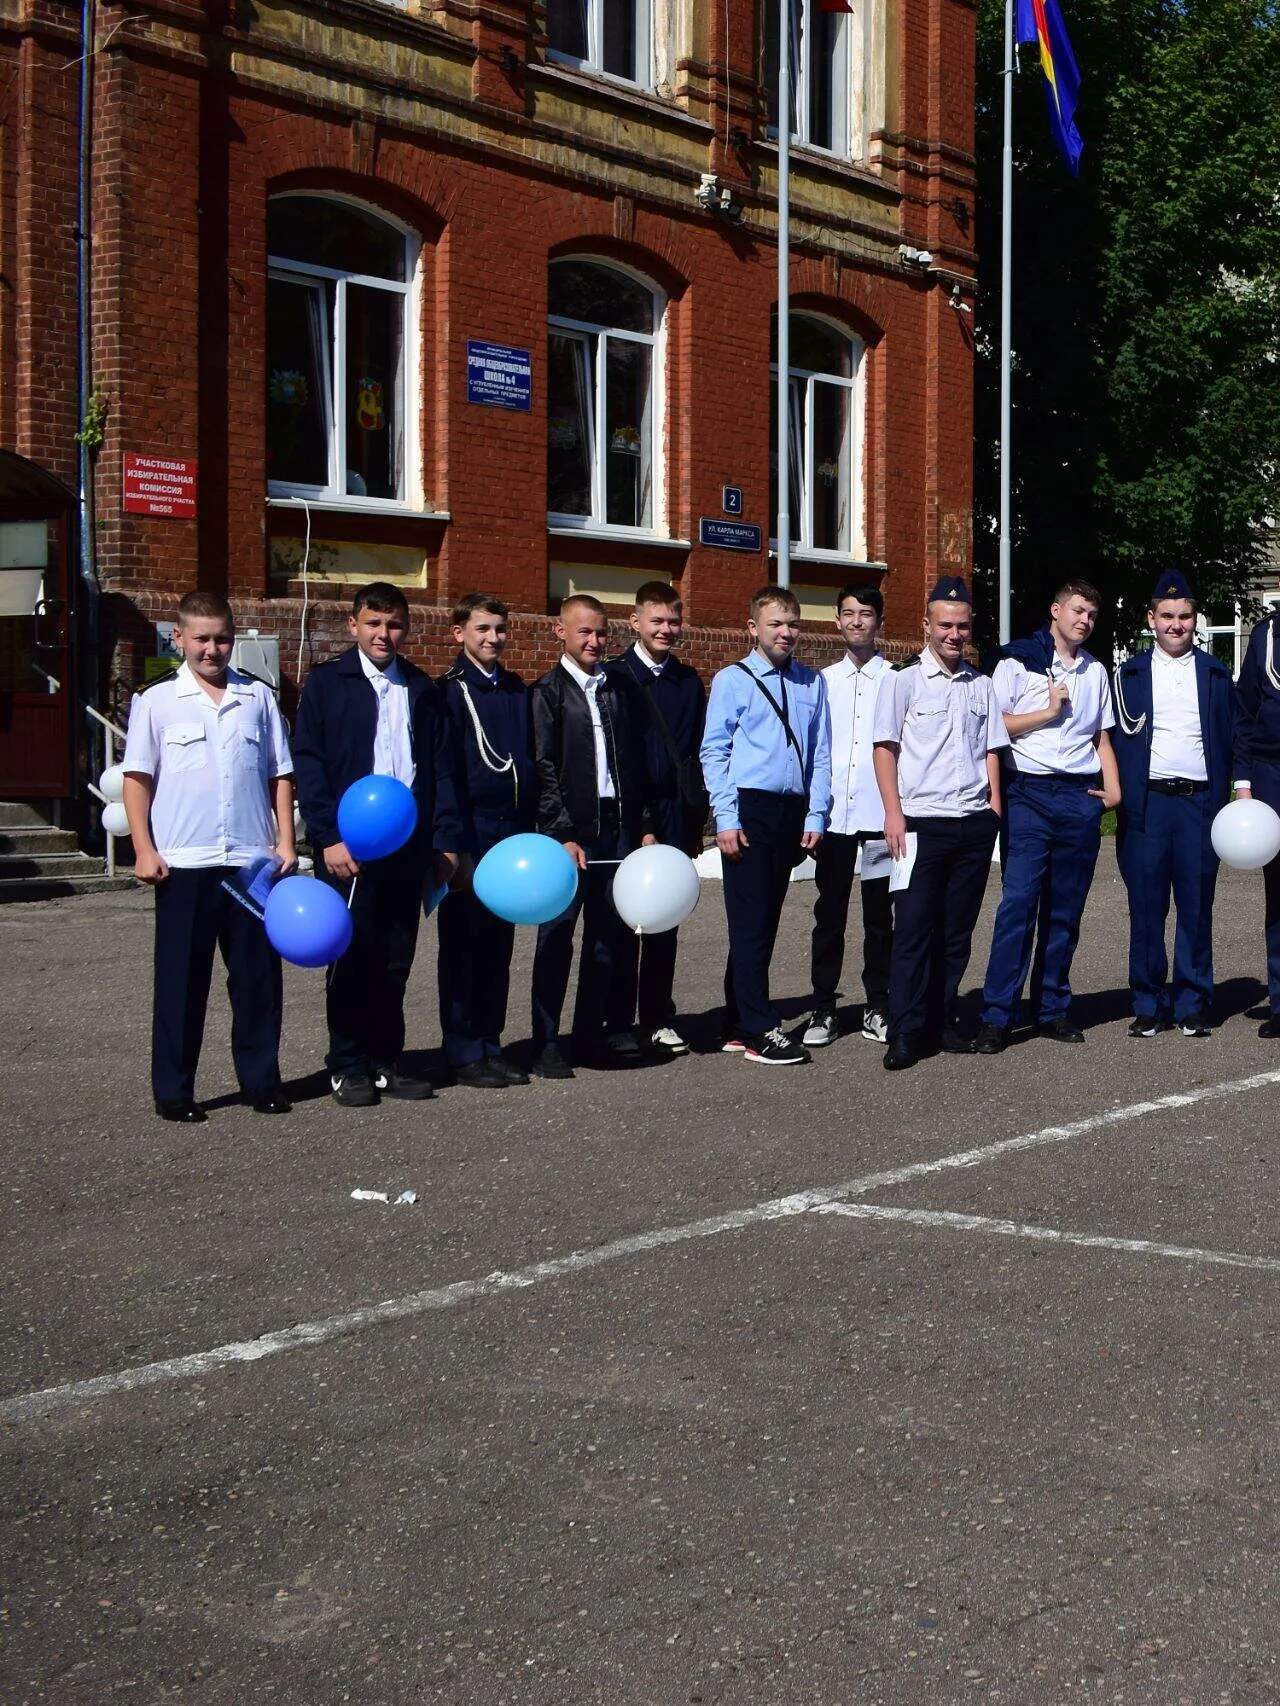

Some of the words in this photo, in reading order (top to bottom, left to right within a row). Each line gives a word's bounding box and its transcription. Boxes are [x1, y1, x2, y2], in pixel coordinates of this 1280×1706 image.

[484, 371, 505, 383] ШКОЛА
[135, 458, 186, 471] УЧАСТКОВАЯ
[127, 469, 193, 484] ИЗБИРАТЕЛЬНАЯ
[140, 483, 182, 495] КОМИССИЯ
[730, 495, 736, 506] 2
